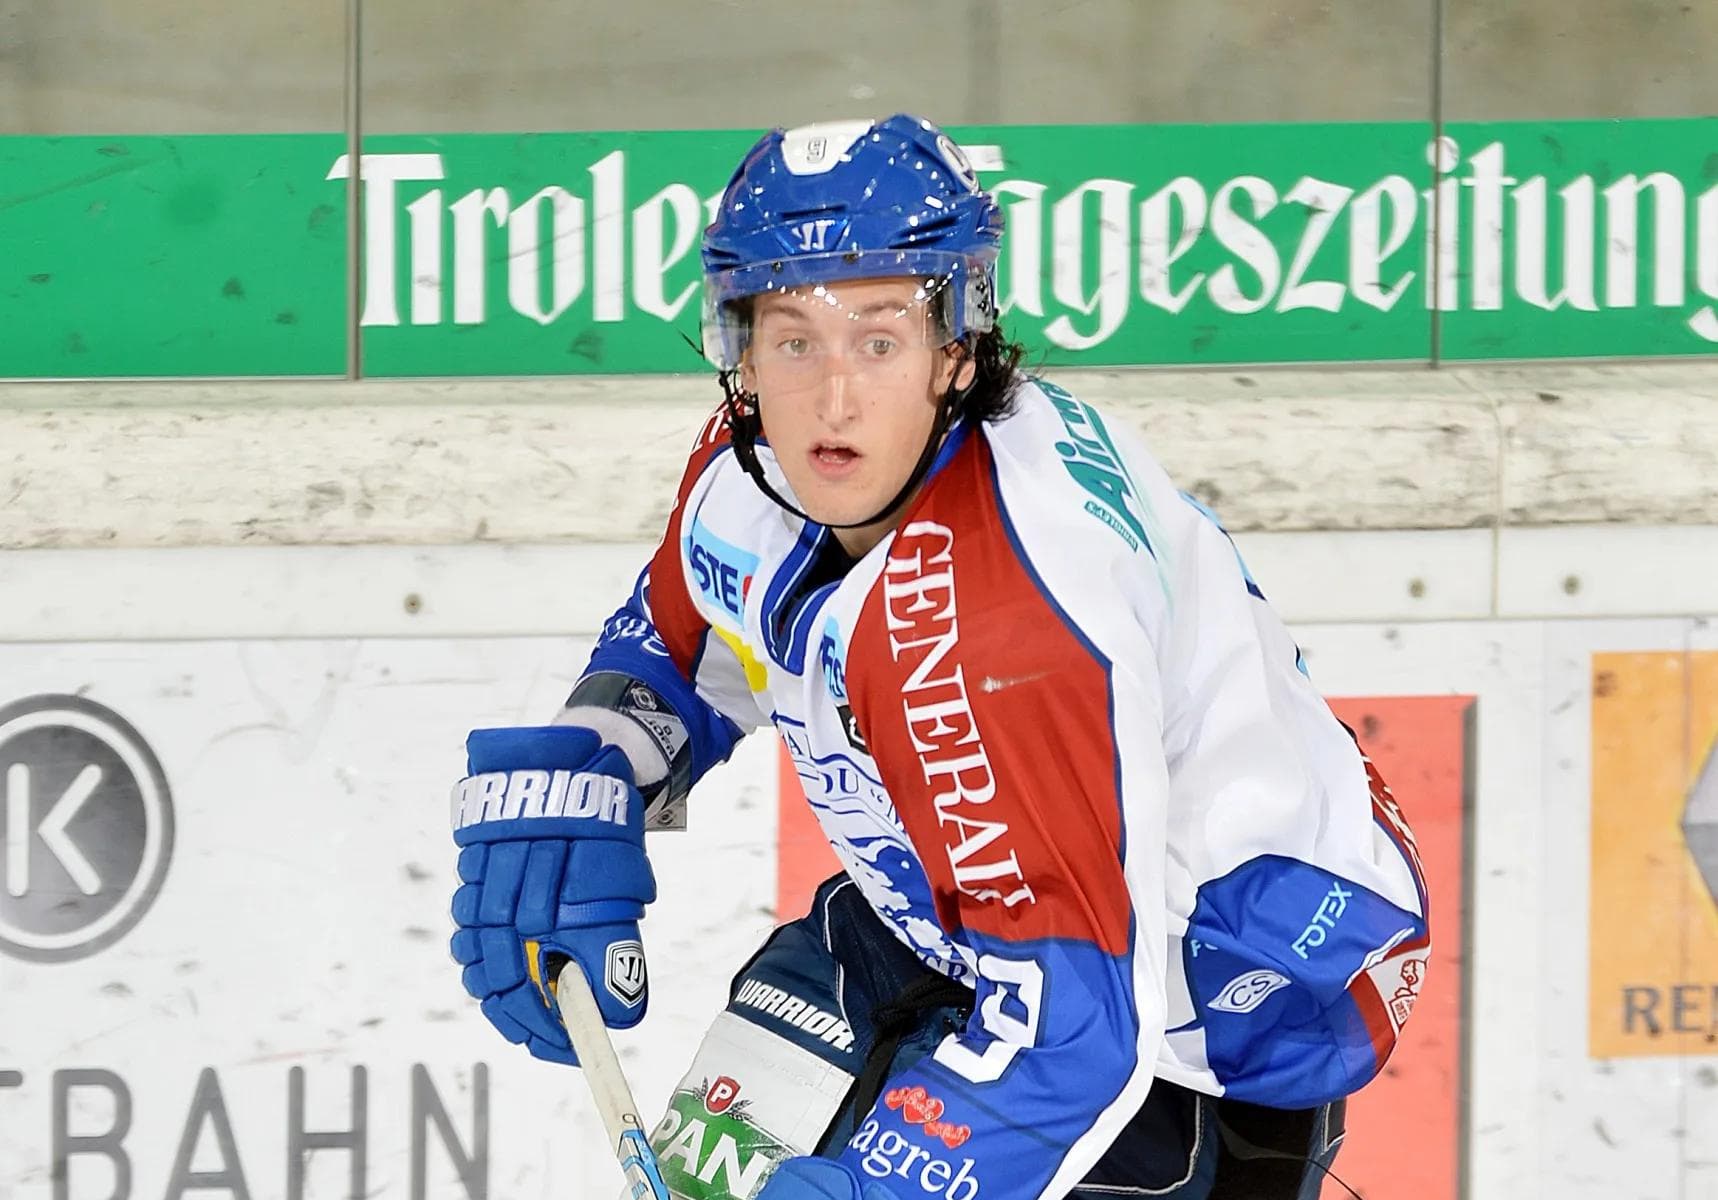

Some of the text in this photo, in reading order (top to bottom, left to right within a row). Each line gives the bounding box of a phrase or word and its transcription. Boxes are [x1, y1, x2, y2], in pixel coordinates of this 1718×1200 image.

[325, 136, 1718, 350] Tirole ageszeitun
[451, 769, 629, 829] ARRIOR
[1291, 881, 1352, 959] FOTEX
[733, 977, 855, 1053] WARRIOR
[1230, 974, 1271, 1007] CS
[1622, 985, 1718, 1037] RE
